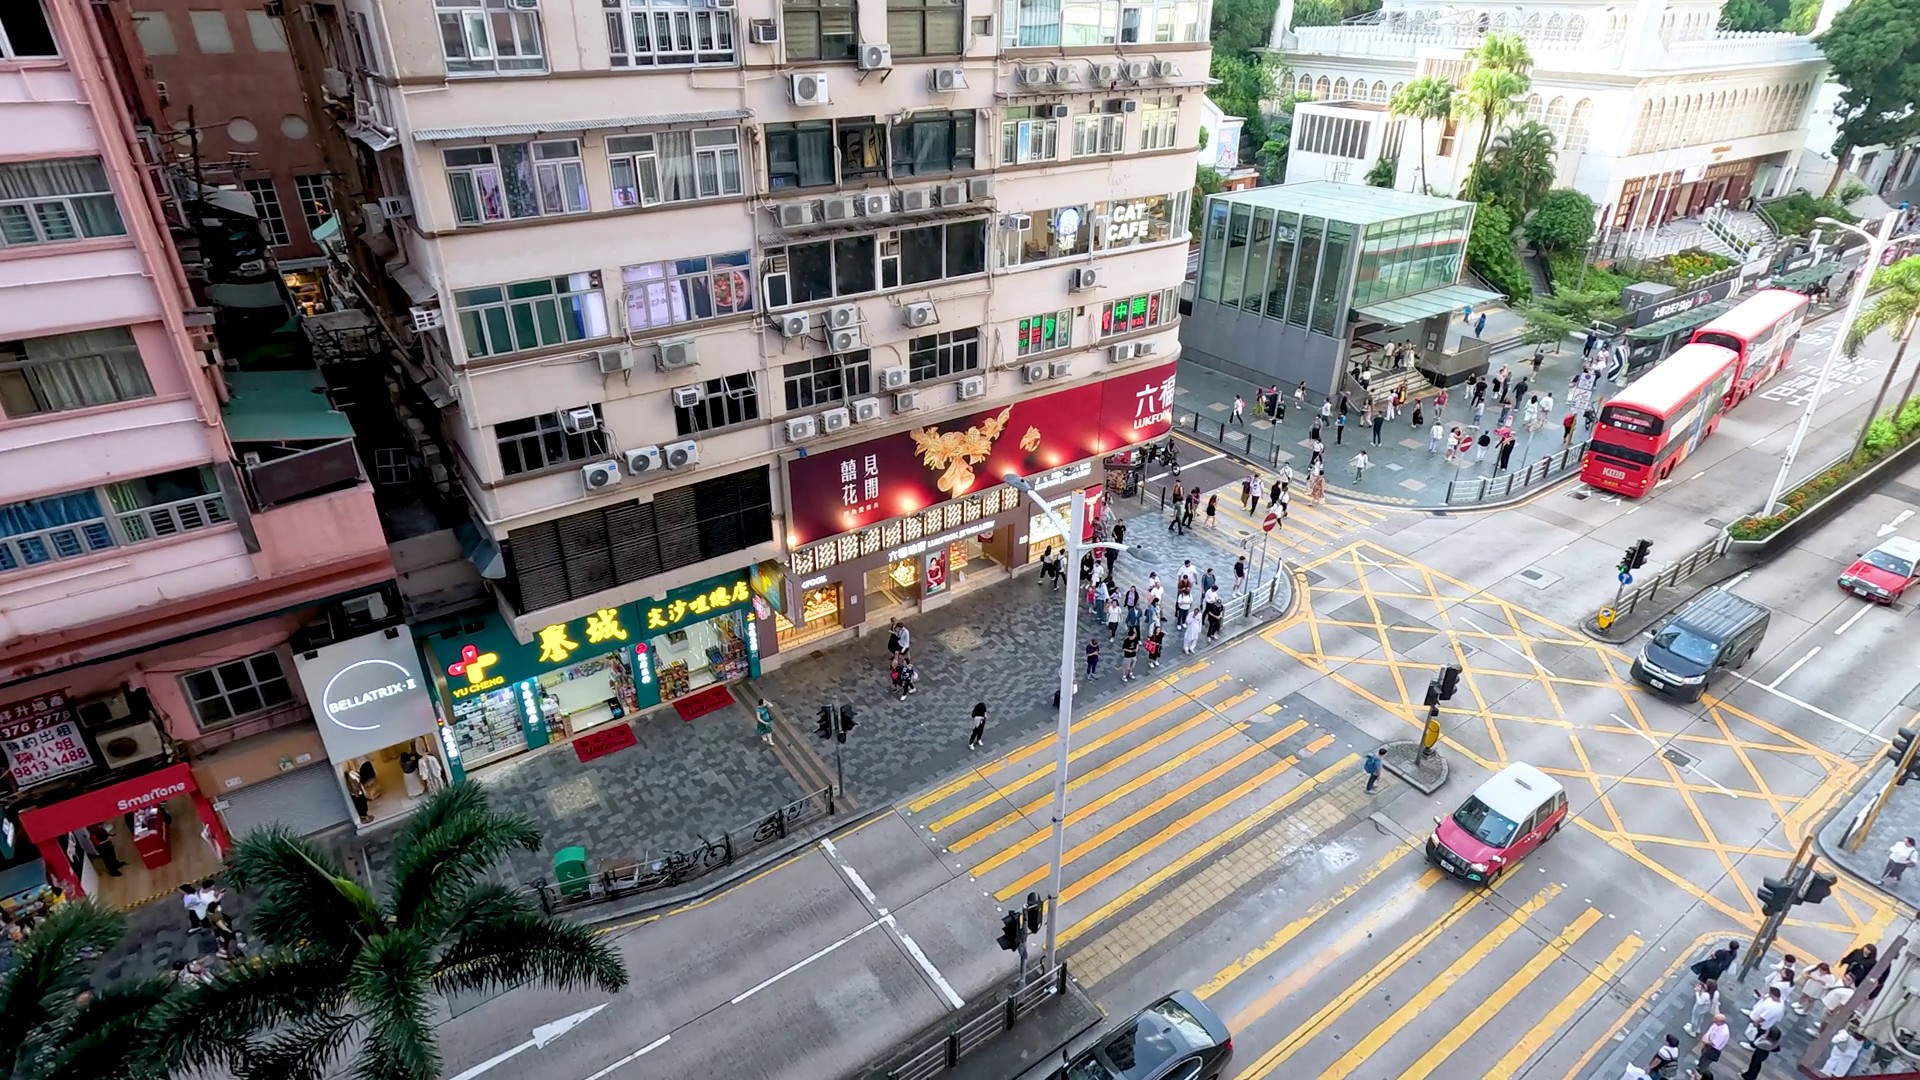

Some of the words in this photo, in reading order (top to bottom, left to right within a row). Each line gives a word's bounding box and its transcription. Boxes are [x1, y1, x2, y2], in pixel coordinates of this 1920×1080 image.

[1113, 203, 1147, 222] CAT
[1107, 220, 1150, 241] CAFE
[1115, 297, 1146, 319] 中華
[1826, 370, 1870, 385] BUS
[1135, 372, 1176, 418] 六福
[1758, 385, 1815, 407] 巴士
[1133, 407, 1172, 430] LUKFO
[647, 581, 749, 629] 尖沙咀總店
[452, 687, 468, 699] YU
[469, 675, 505, 693] CHENG
[34, 710, 71, 729] 2778
[584, 738, 630, 758] Welcome
[13, 761, 49, 778] 9813
[53, 747, 87, 767] 1488
[117, 782, 186, 810] SmarTone
